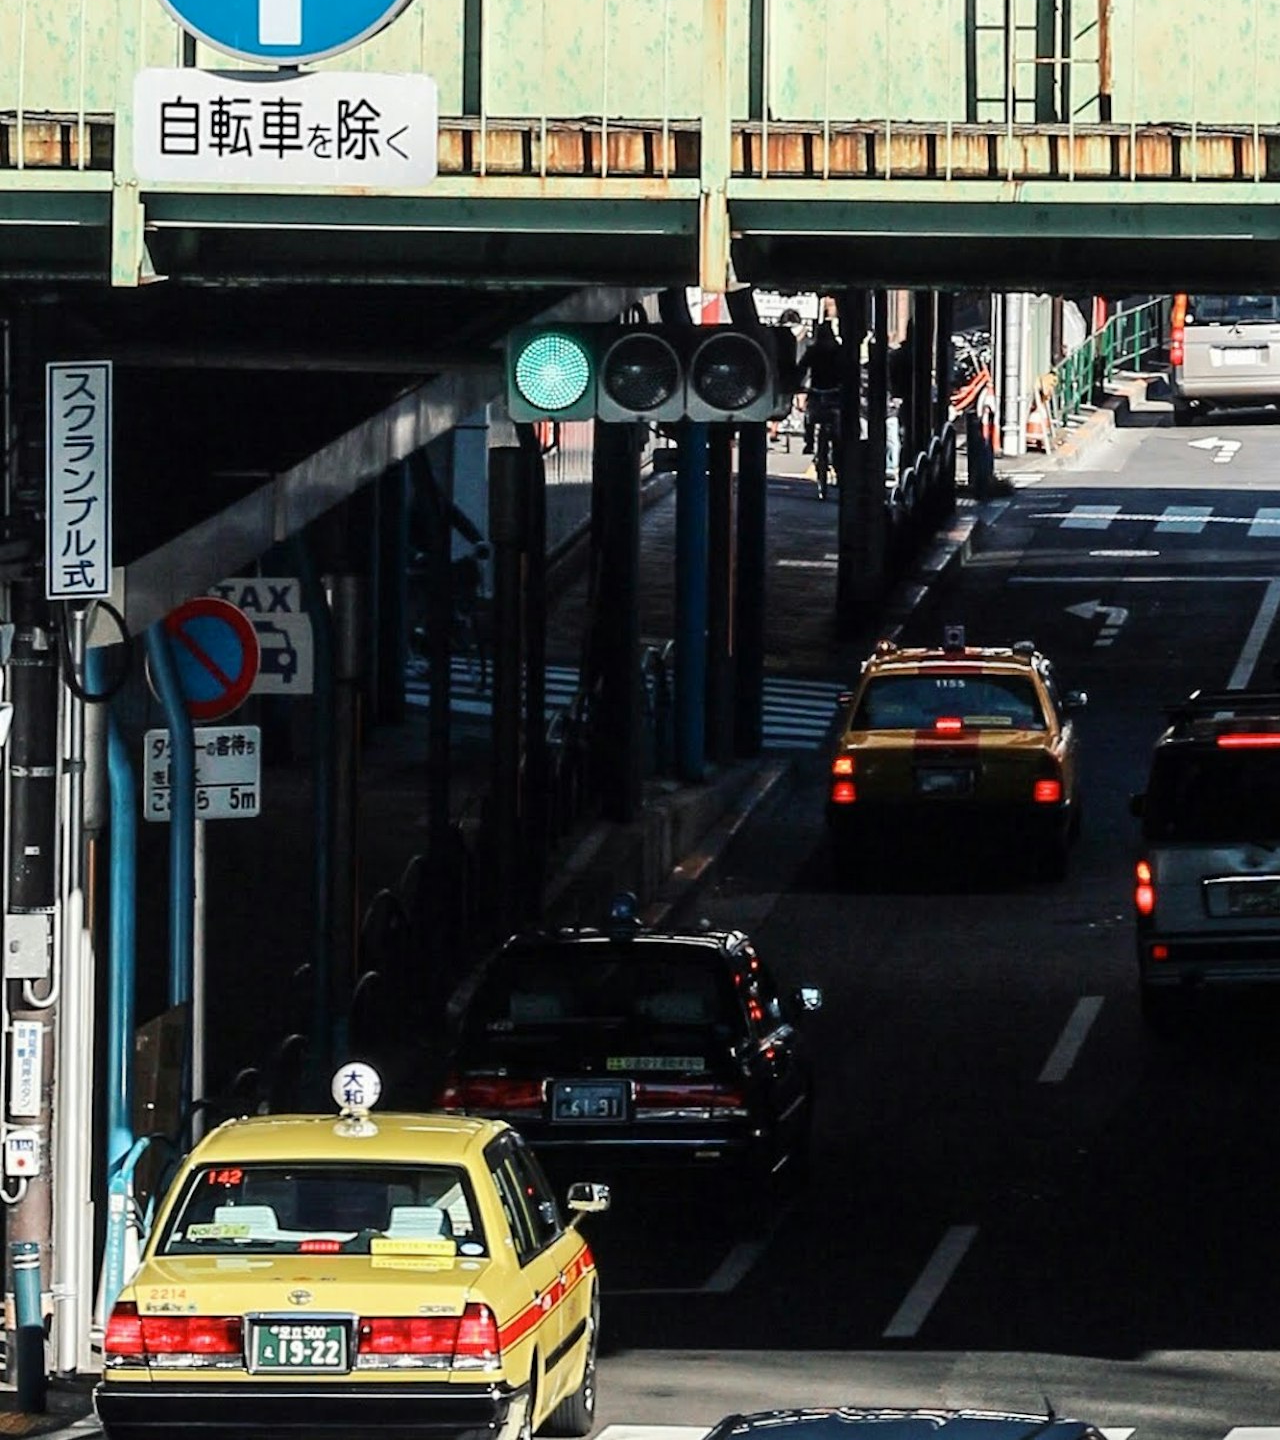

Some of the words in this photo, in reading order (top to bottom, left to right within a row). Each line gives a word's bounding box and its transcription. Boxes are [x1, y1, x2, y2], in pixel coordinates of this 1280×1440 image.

[160, 95, 409, 160] 自転車を除く
[62, 373, 98, 589] スクランブル式
[152, 735, 257, 759] ターの客待ち
[229, 786, 257, 811] 5m
[343, 1073, 365, 1105] 大和
[208, 1170, 242, 1185] 142
[150, 1289, 186, 1300] 2214
[279, 1340, 340, 1365] 19-22
